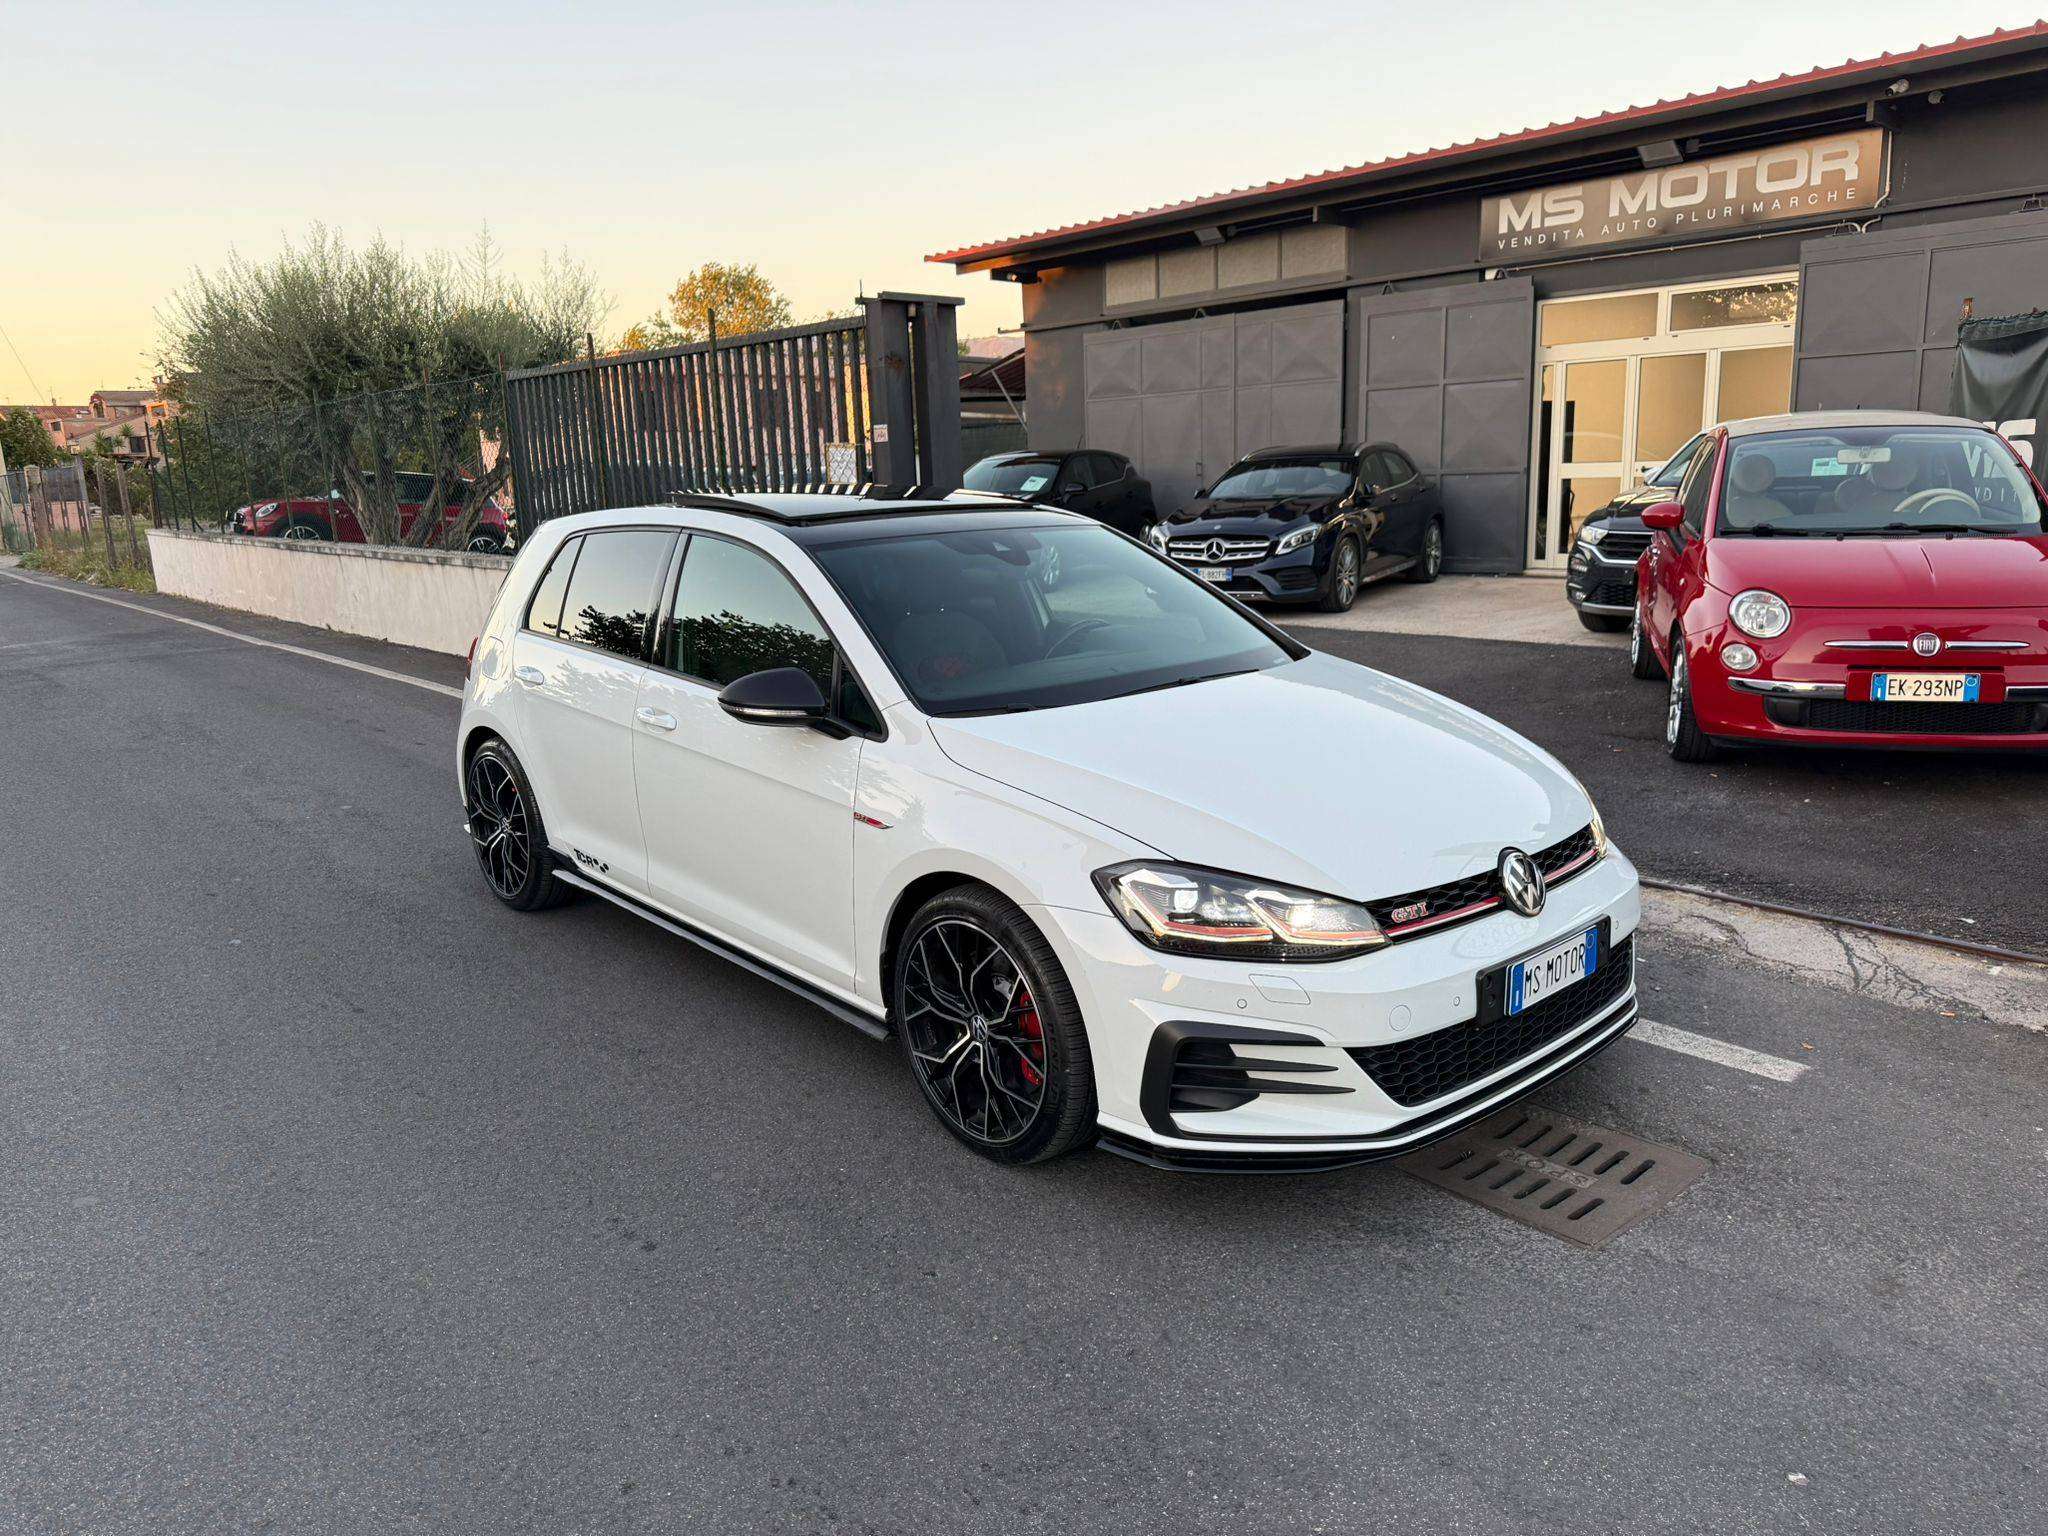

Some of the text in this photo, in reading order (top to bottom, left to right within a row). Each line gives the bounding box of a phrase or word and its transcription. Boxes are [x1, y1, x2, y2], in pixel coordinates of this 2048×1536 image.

[1498, 141, 1860, 234] MS MOTOR
[1498, 187, 1857, 250] VENDITA AUTO PLURIMARCHE
[1918, 638, 1936, 651] FIAT
[1887, 678, 1908, 696] EK
[1912, 679, 1964, 697] 293NP
[1391, 901, 1428, 924] GTI
[1523, 964, 1541, 1000] MS
[1545, 943, 1586, 992] MOTOR
